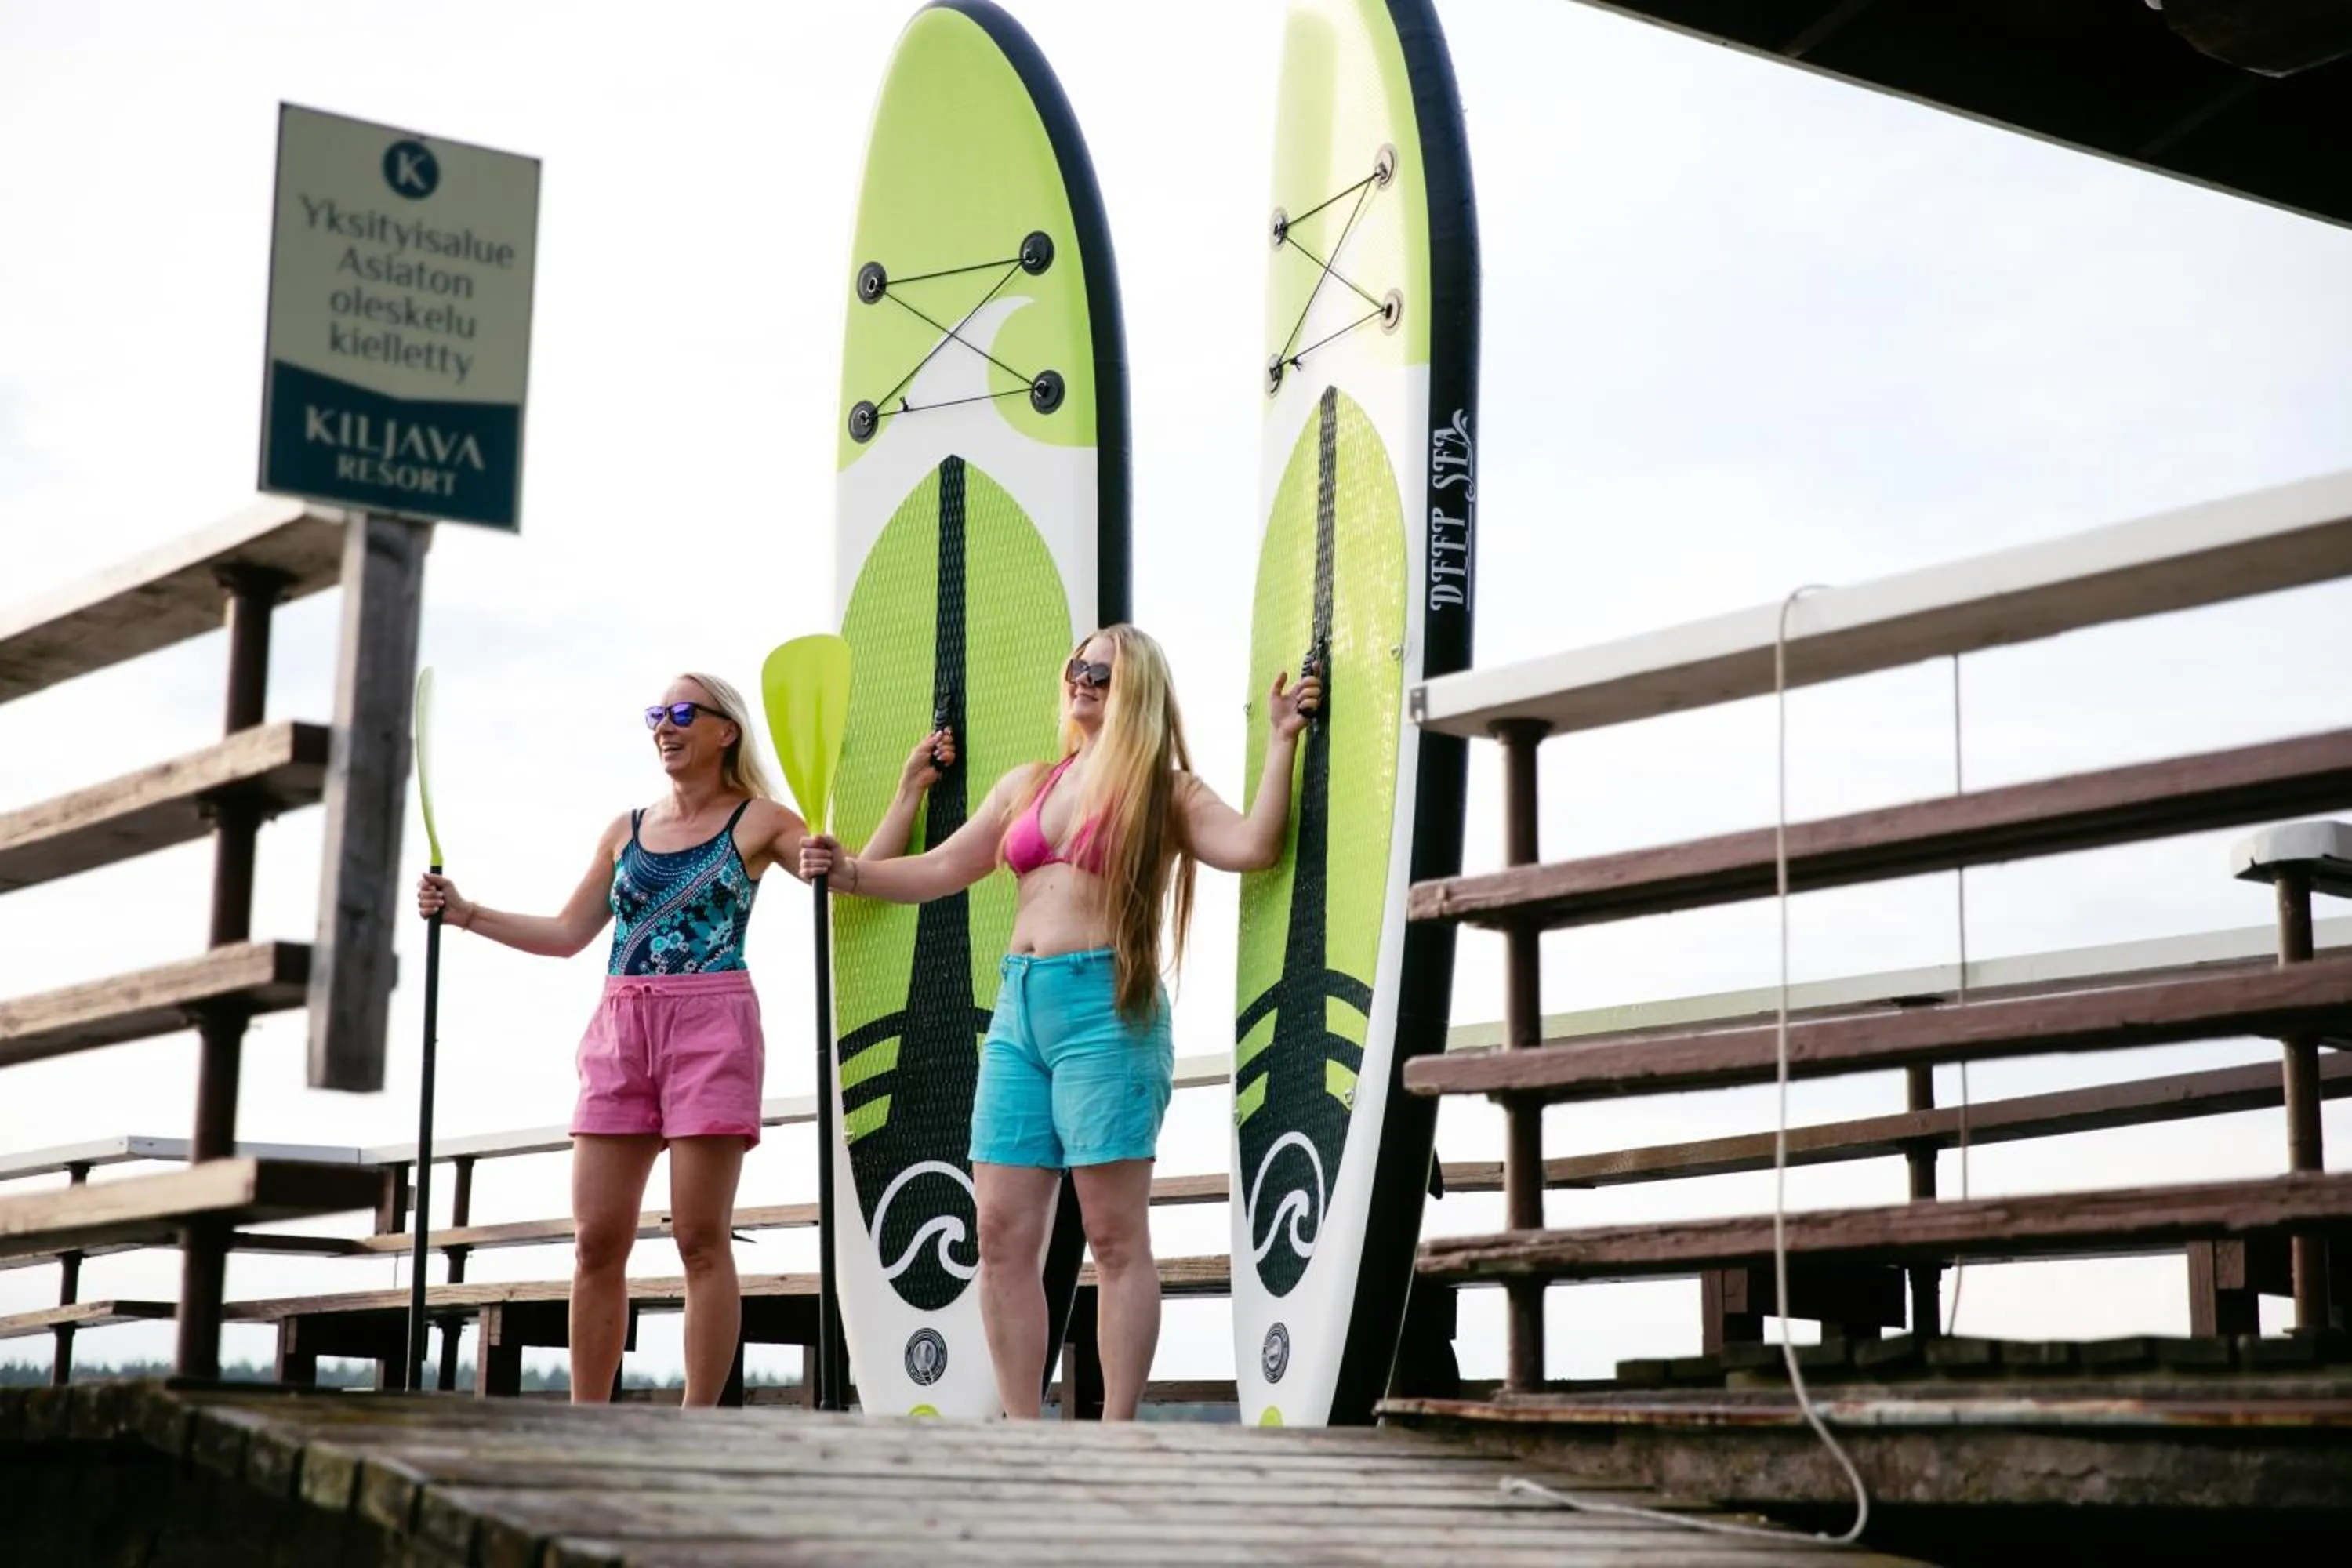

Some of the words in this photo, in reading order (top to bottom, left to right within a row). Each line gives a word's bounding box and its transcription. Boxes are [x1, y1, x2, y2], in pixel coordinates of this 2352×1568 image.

[397, 149, 427, 191] K
[298, 193, 516, 269] Yksityisalue
[337, 245, 475, 299] Asiaton
[329, 285, 477, 339] oleskelu
[329, 320, 474, 385] kielletty
[304, 405, 485, 471] KILJAVA
[1432, 408, 1476, 502] SEA
[337, 452, 456, 498] RESORT
[1430, 506, 1469, 611] DEEP
